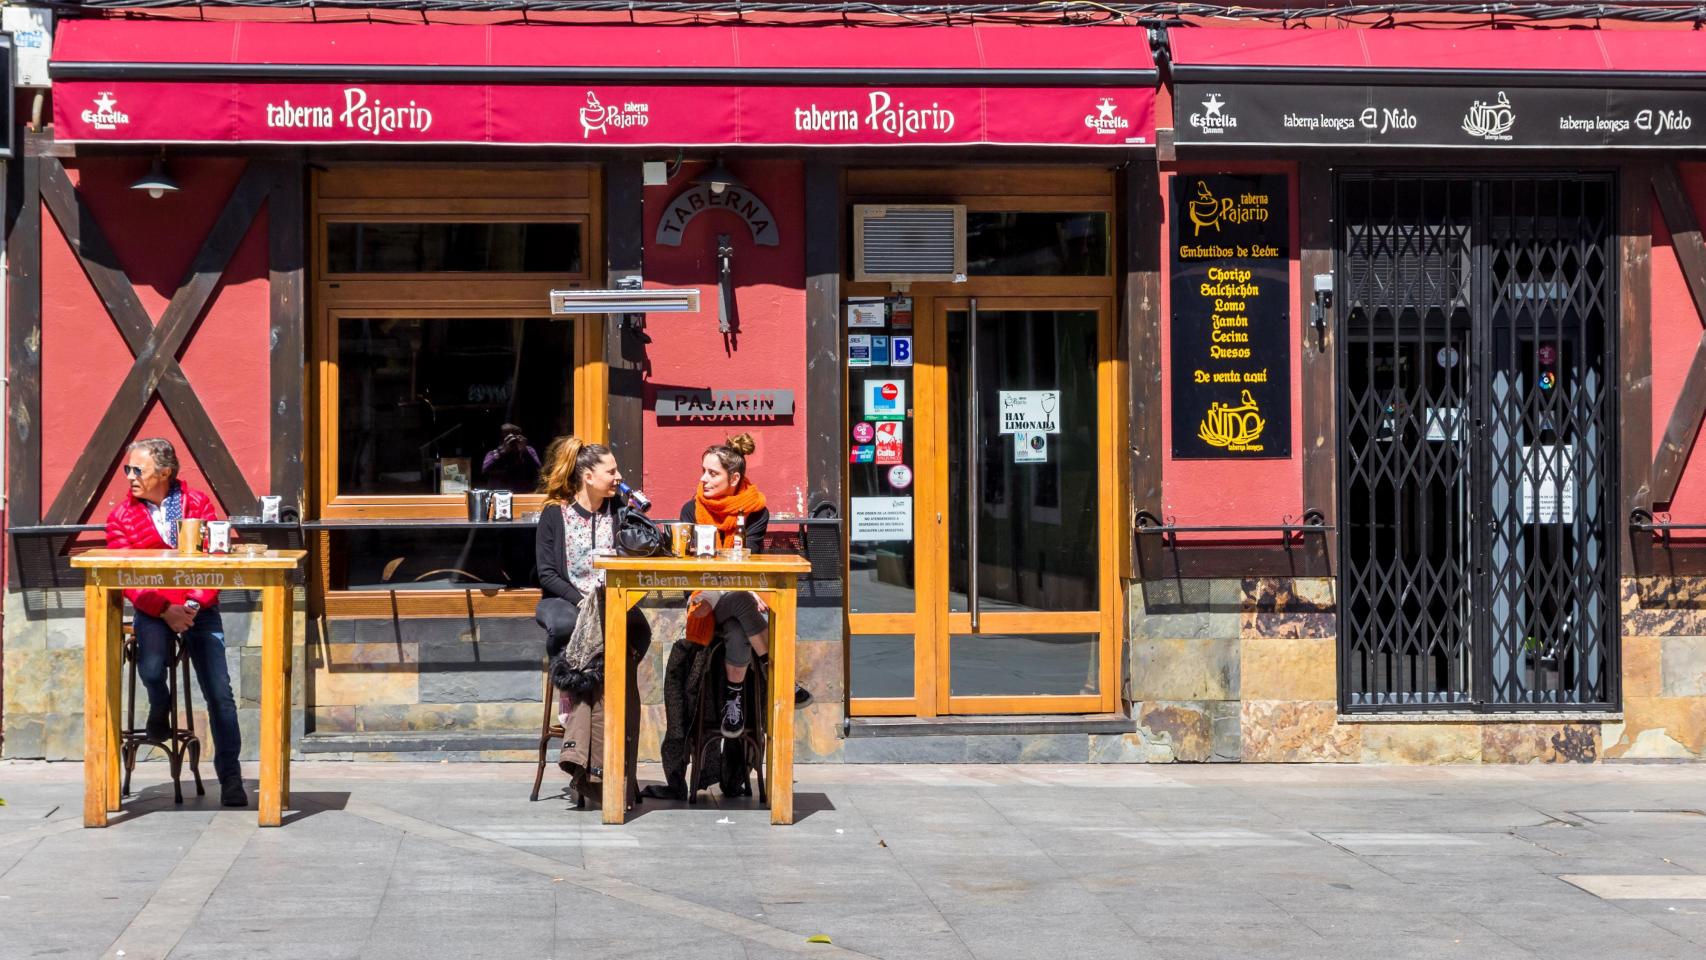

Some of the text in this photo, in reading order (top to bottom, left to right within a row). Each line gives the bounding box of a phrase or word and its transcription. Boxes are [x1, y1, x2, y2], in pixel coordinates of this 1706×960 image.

[266, 87, 432, 136] taberna Pajarin
[623, 101, 649, 112] taberna
[794, 91, 955, 138] taberna Pajarin
[81, 109, 129, 124] Estrella
[605, 105, 649, 129] Pajarin
[1084, 114, 1129, 129] Estrella
[1190, 112, 1237, 128] Estrella
[1283, 107, 1417, 134] taberna leonesa El Nido
[1560, 109, 1692, 135] taberna leonesa El Nido
[1202, 126, 1224, 135] Damm
[1240, 193, 1269, 205] taberna
[663, 189, 769, 236] TABERNA
[1219, 197, 1269, 225] Pajarin
[1180, 245, 1234, 258] Embutidos
[1236, 245, 1249, 258] de
[1208, 267, 1252, 283] Chorizo
[1200, 283, 1260, 298] Salchichón
[1214, 298, 1246, 312] Lomo
[1211, 314, 1249, 330] Jamón
[1211, 330, 1249, 343] Cecina
[894, 339, 910, 361] B
[1210, 345, 1251, 359] Quesos
[1194, 368, 1267, 383] De venta aquí
[674, 394, 774, 411] PAJARIN
[1005, 412, 1025, 421] HAY
[1005, 421, 1056, 430] LIMONADA
[117, 569, 224, 587] taberna Pajarin
[636, 571, 753, 587] taberna Pajarin
